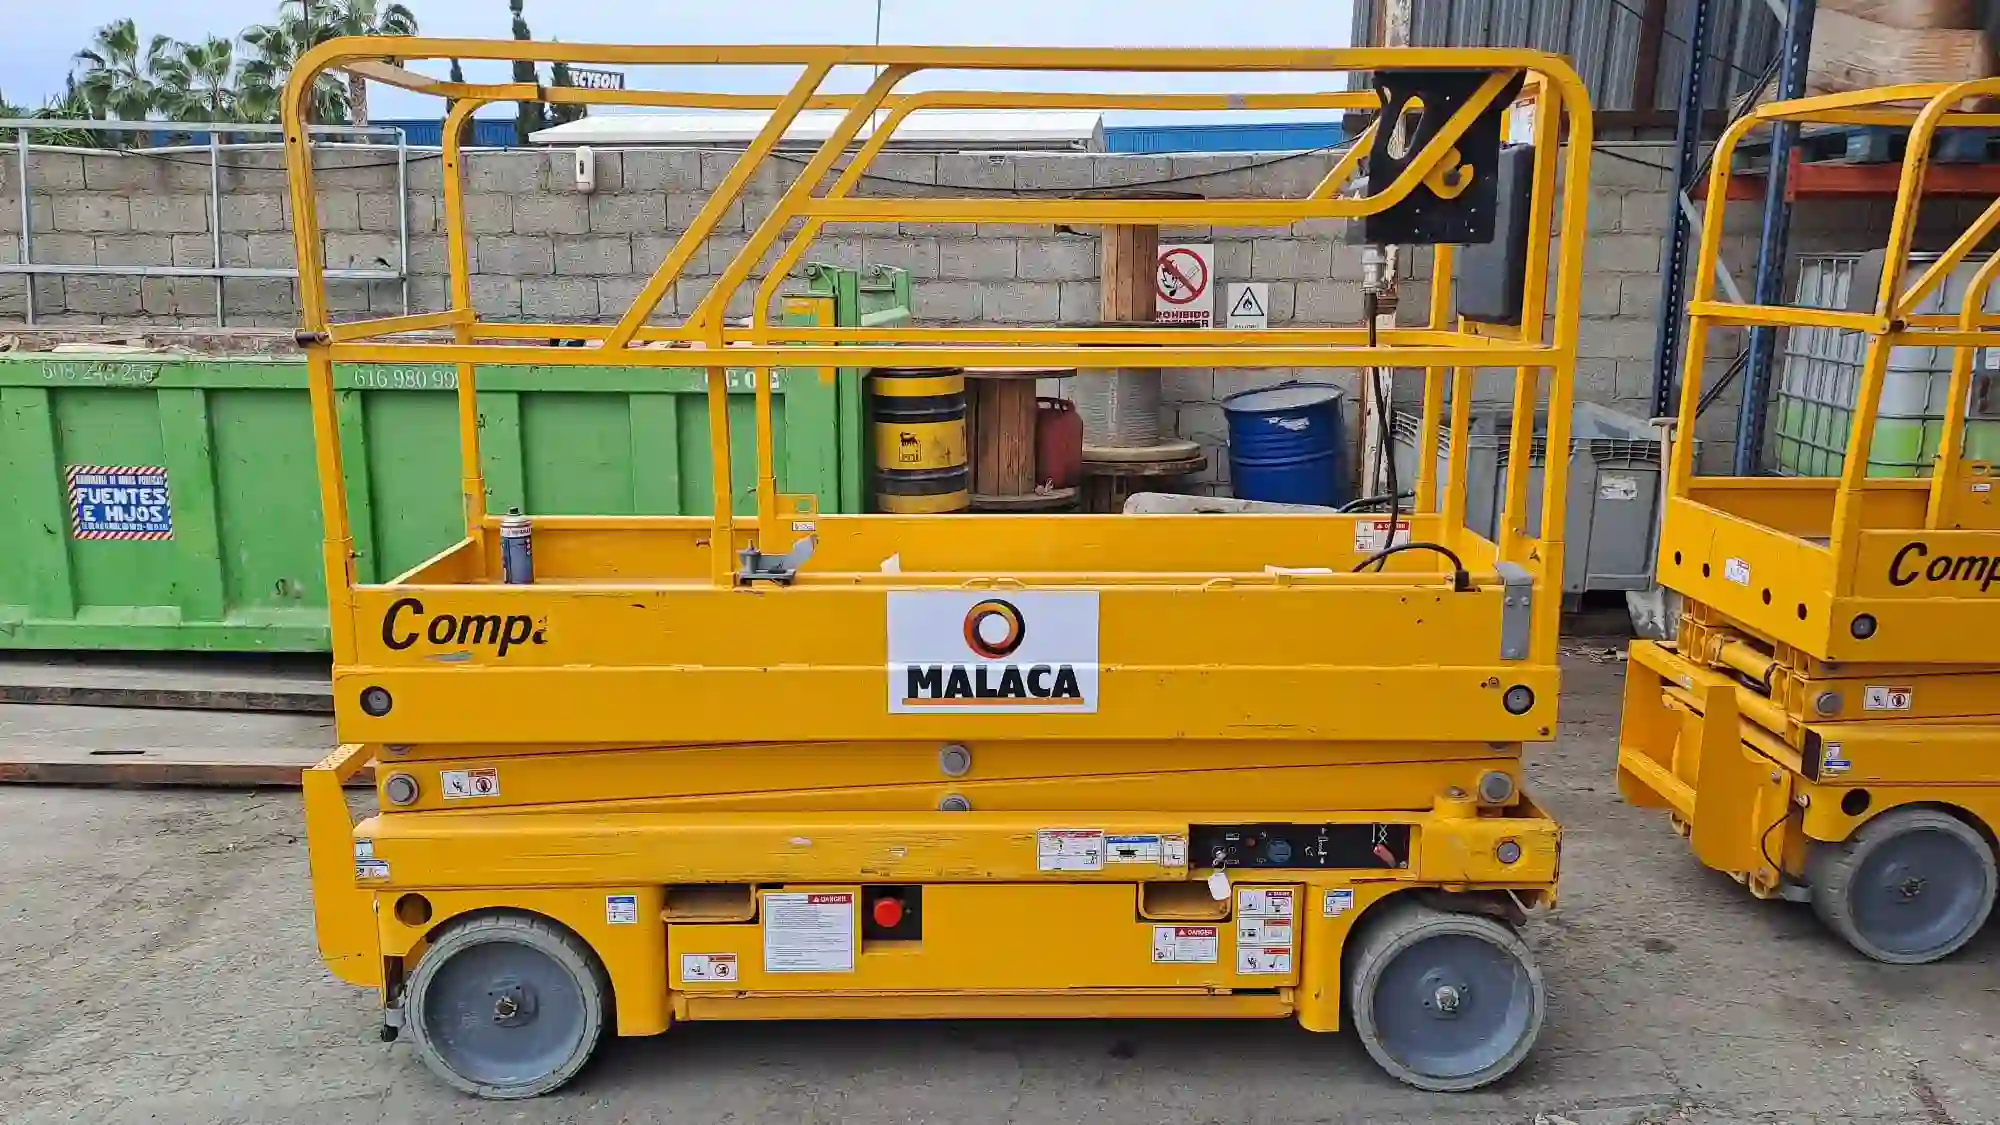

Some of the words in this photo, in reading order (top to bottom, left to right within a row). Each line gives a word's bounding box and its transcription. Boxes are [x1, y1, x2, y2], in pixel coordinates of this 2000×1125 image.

[355, 369, 387, 387] 616
[394, 370, 427, 388] 980
[77, 488, 166, 504] FUENTES
[83, 505, 96, 521] E
[105, 506, 162, 522] HIJOS
[907, 665, 1081, 698] MALACA
[1187, 928, 1213, 936] DANGER
